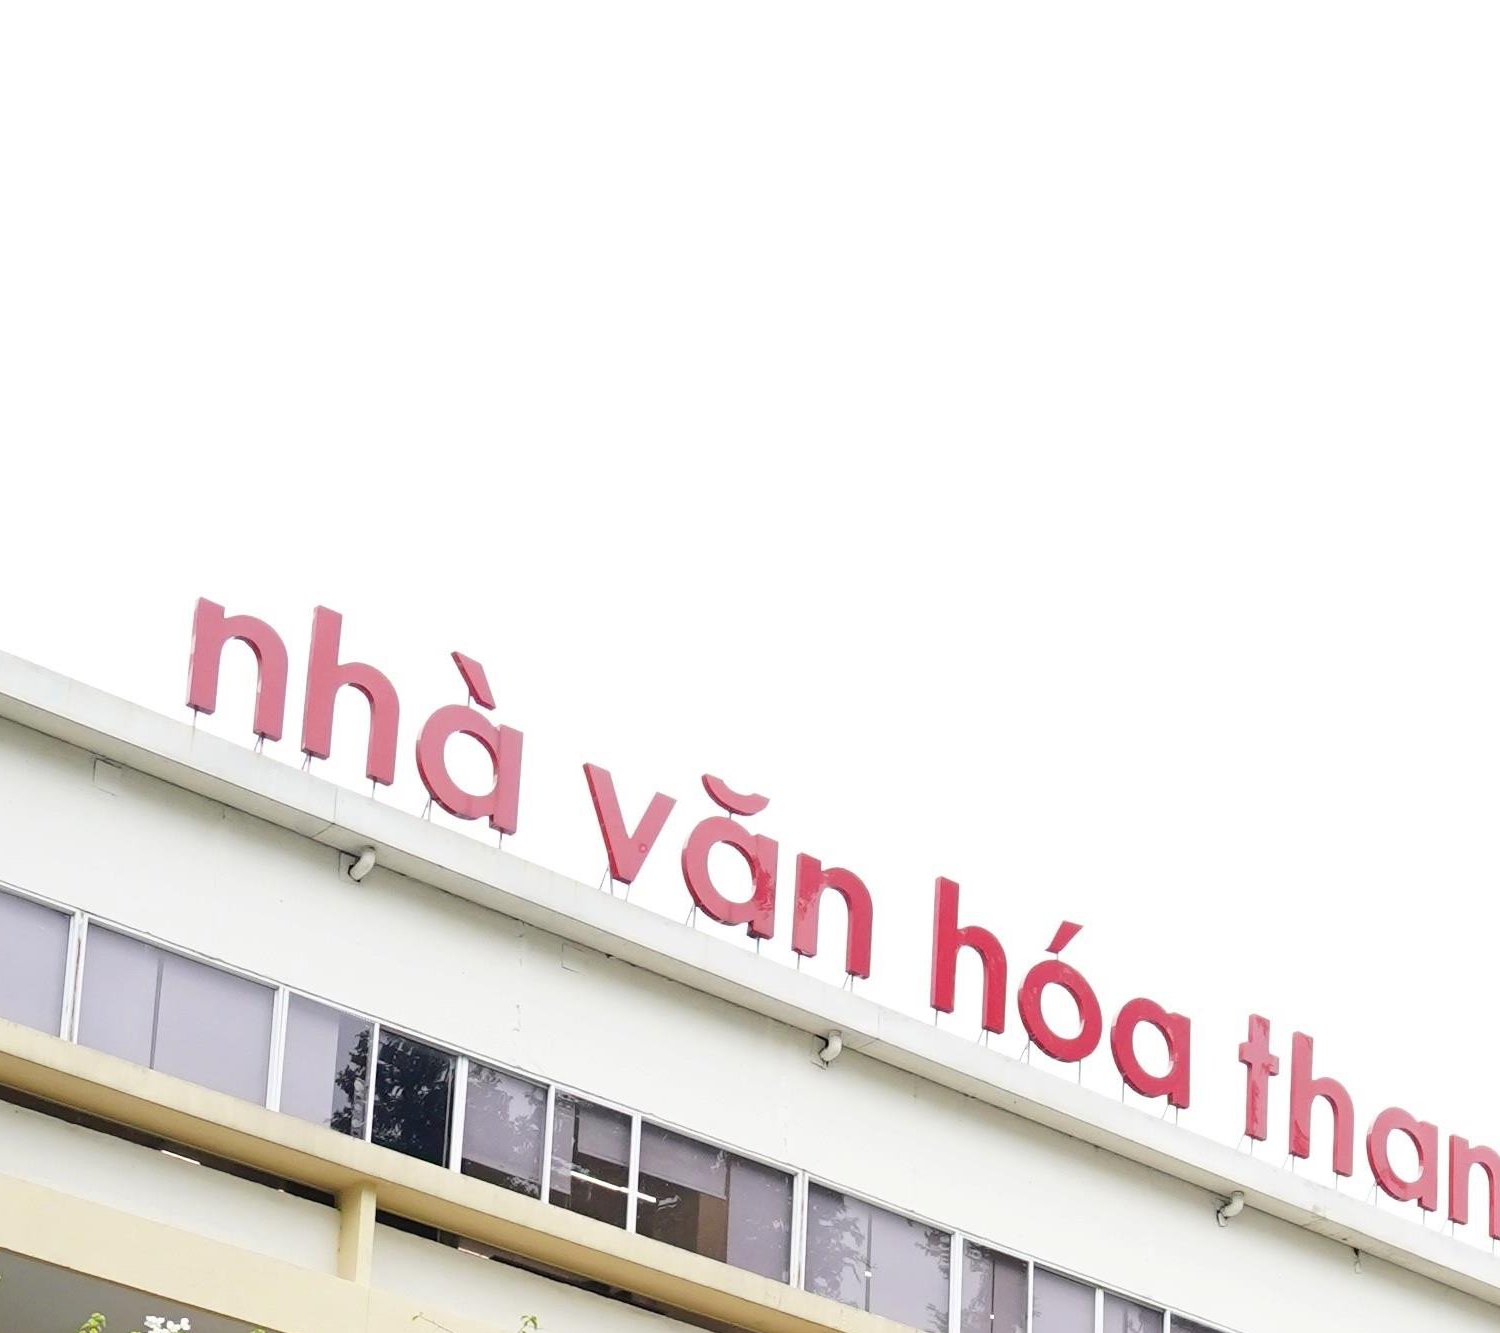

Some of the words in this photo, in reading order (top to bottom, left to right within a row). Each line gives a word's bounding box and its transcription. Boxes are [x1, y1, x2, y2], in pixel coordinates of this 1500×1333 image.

[187, 595, 523, 834] nhà
[582, 763, 874, 979] văn
[931, 877, 1191, 1109] hóa
